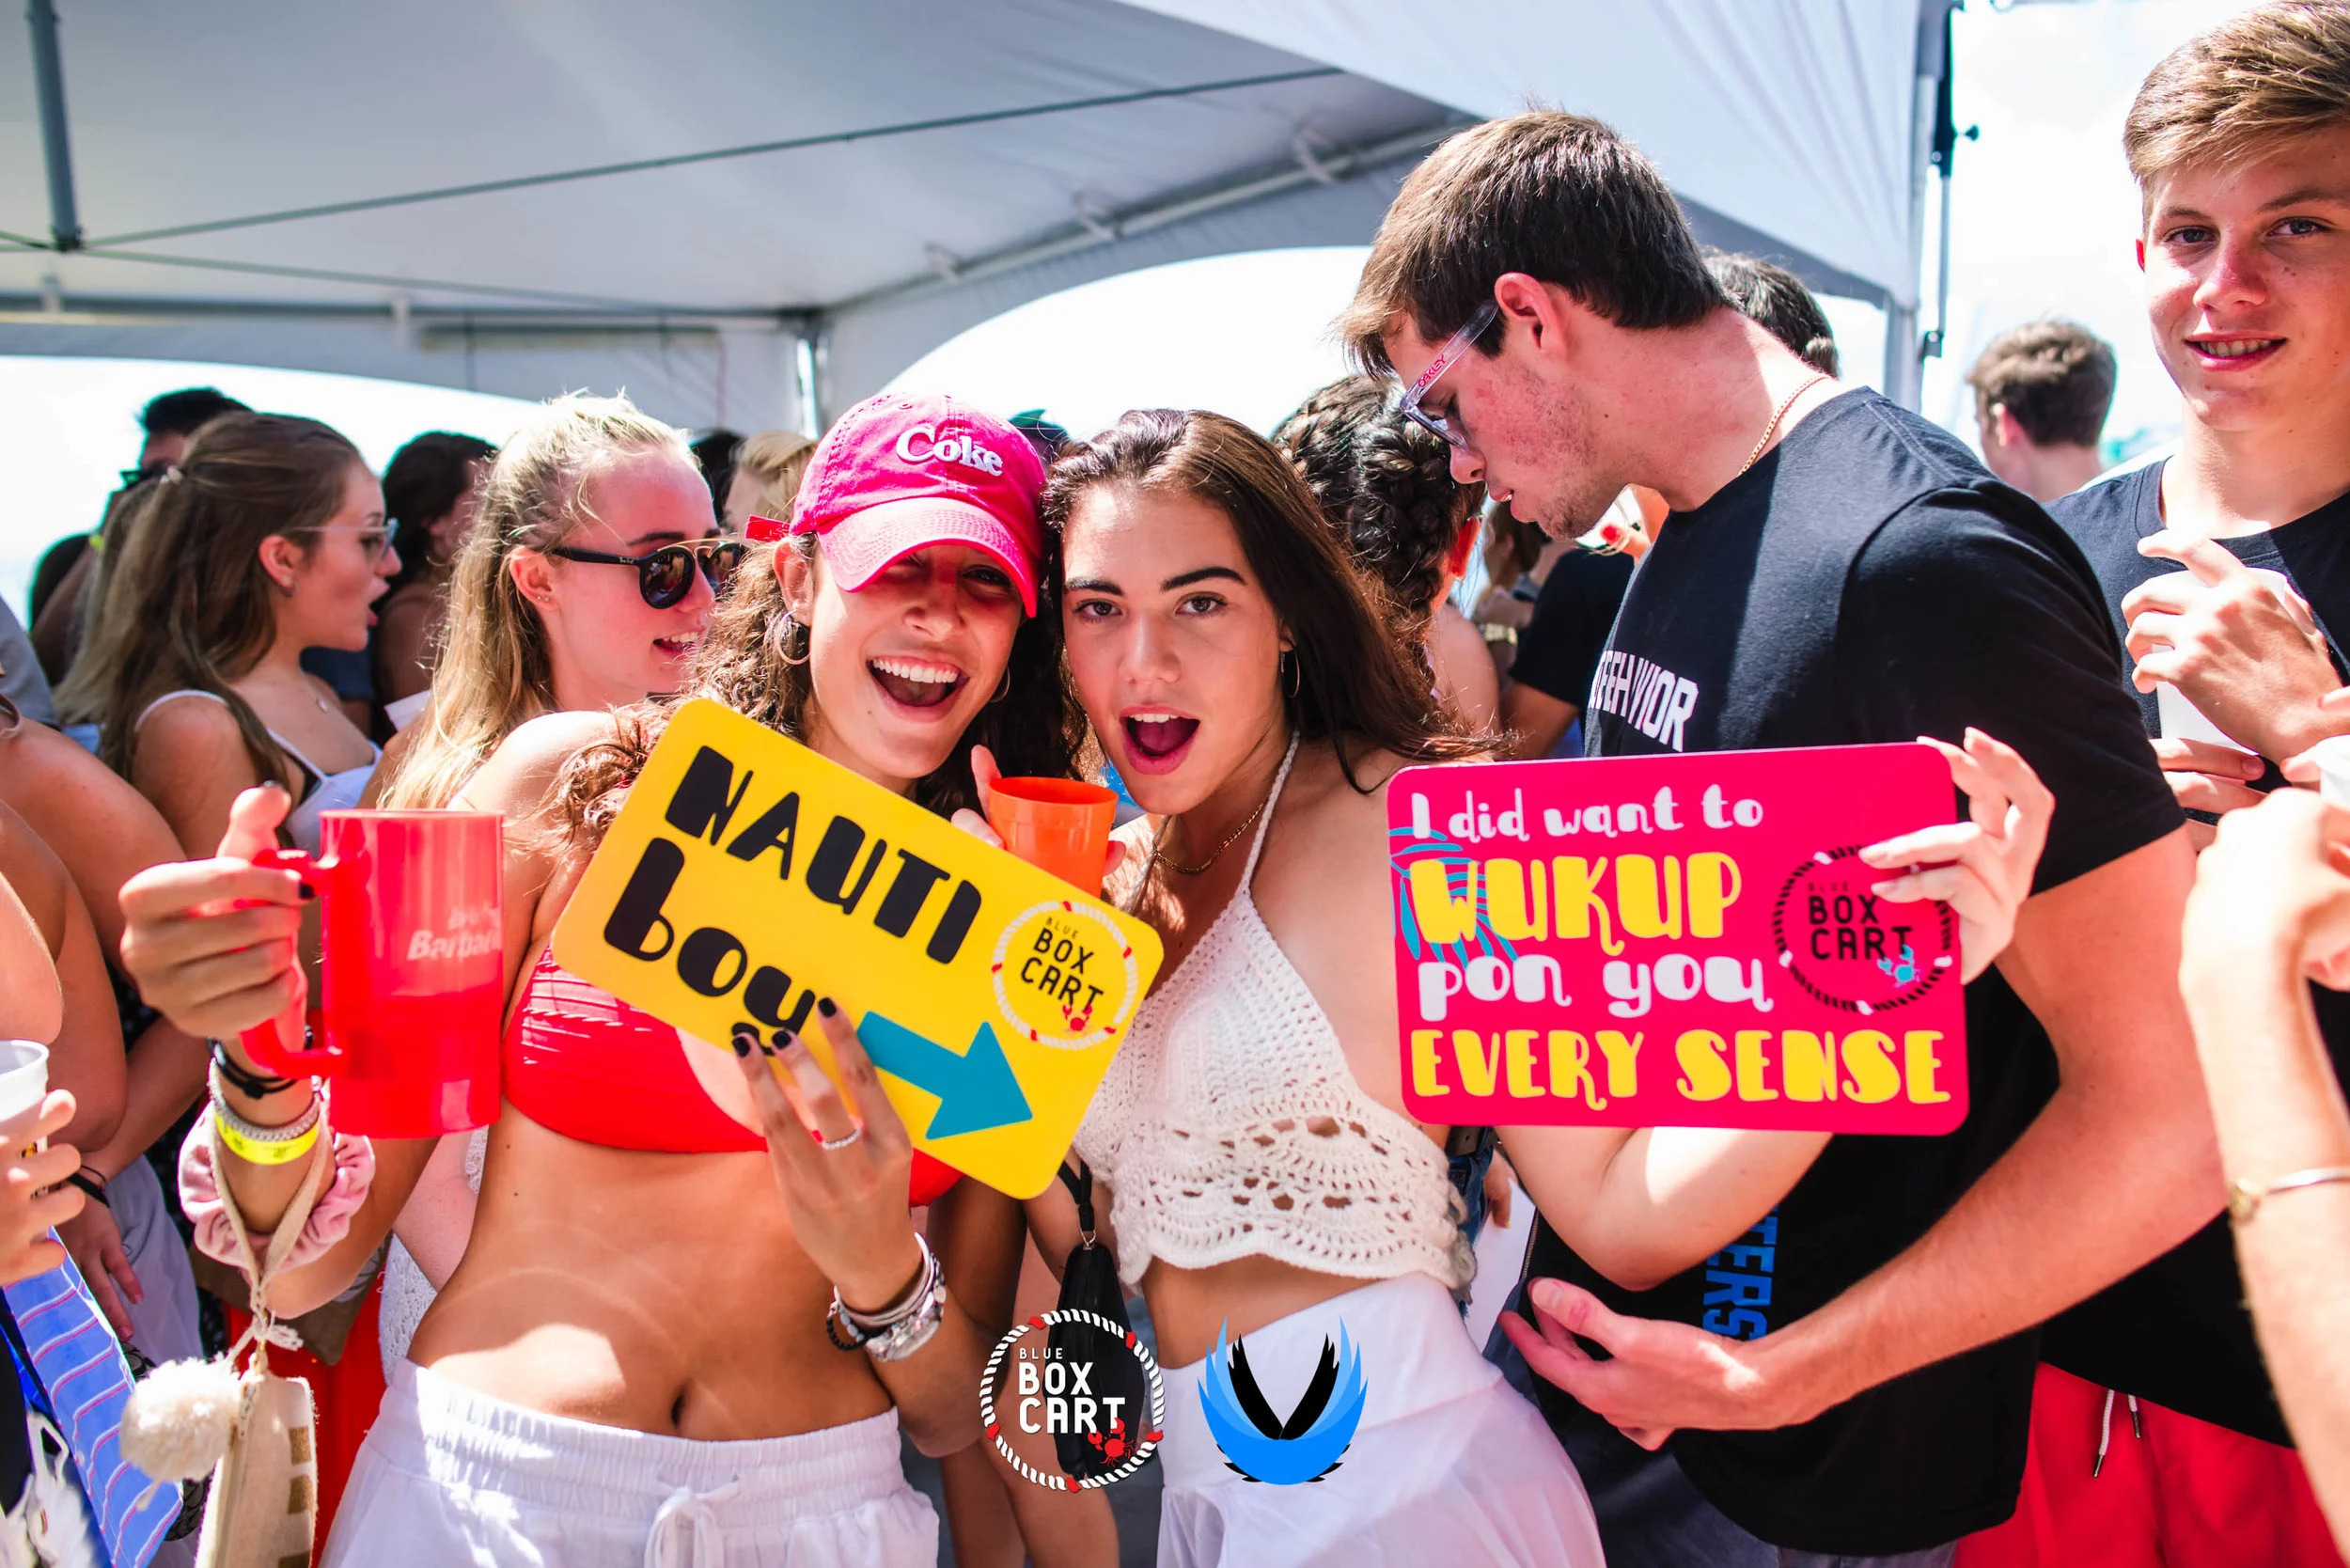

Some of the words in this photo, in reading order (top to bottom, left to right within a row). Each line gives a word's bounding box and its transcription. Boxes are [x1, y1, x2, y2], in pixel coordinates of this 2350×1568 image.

[1418, 354, 1446, 387] OAKLEY
[896, 425, 1003, 477] Coke
[1411, 792, 1431, 839] I
[1449, 788, 1530, 843] did
[1543, 785, 1684, 839] want
[1701, 784, 1763, 829] to
[665, 745, 982, 964] NAUTI
[1045, 917, 1079, 939] BLUE
[1409, 852, 1742, 956] WUKUP
[1809, 894, 1879, 924] BOX
[603, 838, 816, 1057] boy
[1033, 927, 1094, 975] BOX
[1811, 926, 1913, 961] CART
[1021, 957, 1104, 1011] CART
[1418, 954, 1572, 1022] pon
[1603, 953, 1774, 1018] you
[1410, 1028, 1644, 1110] EVERY
[1675, 1028, 1951, 1104] SENSE
[1702, 1203, 1779, 1341] TERS
